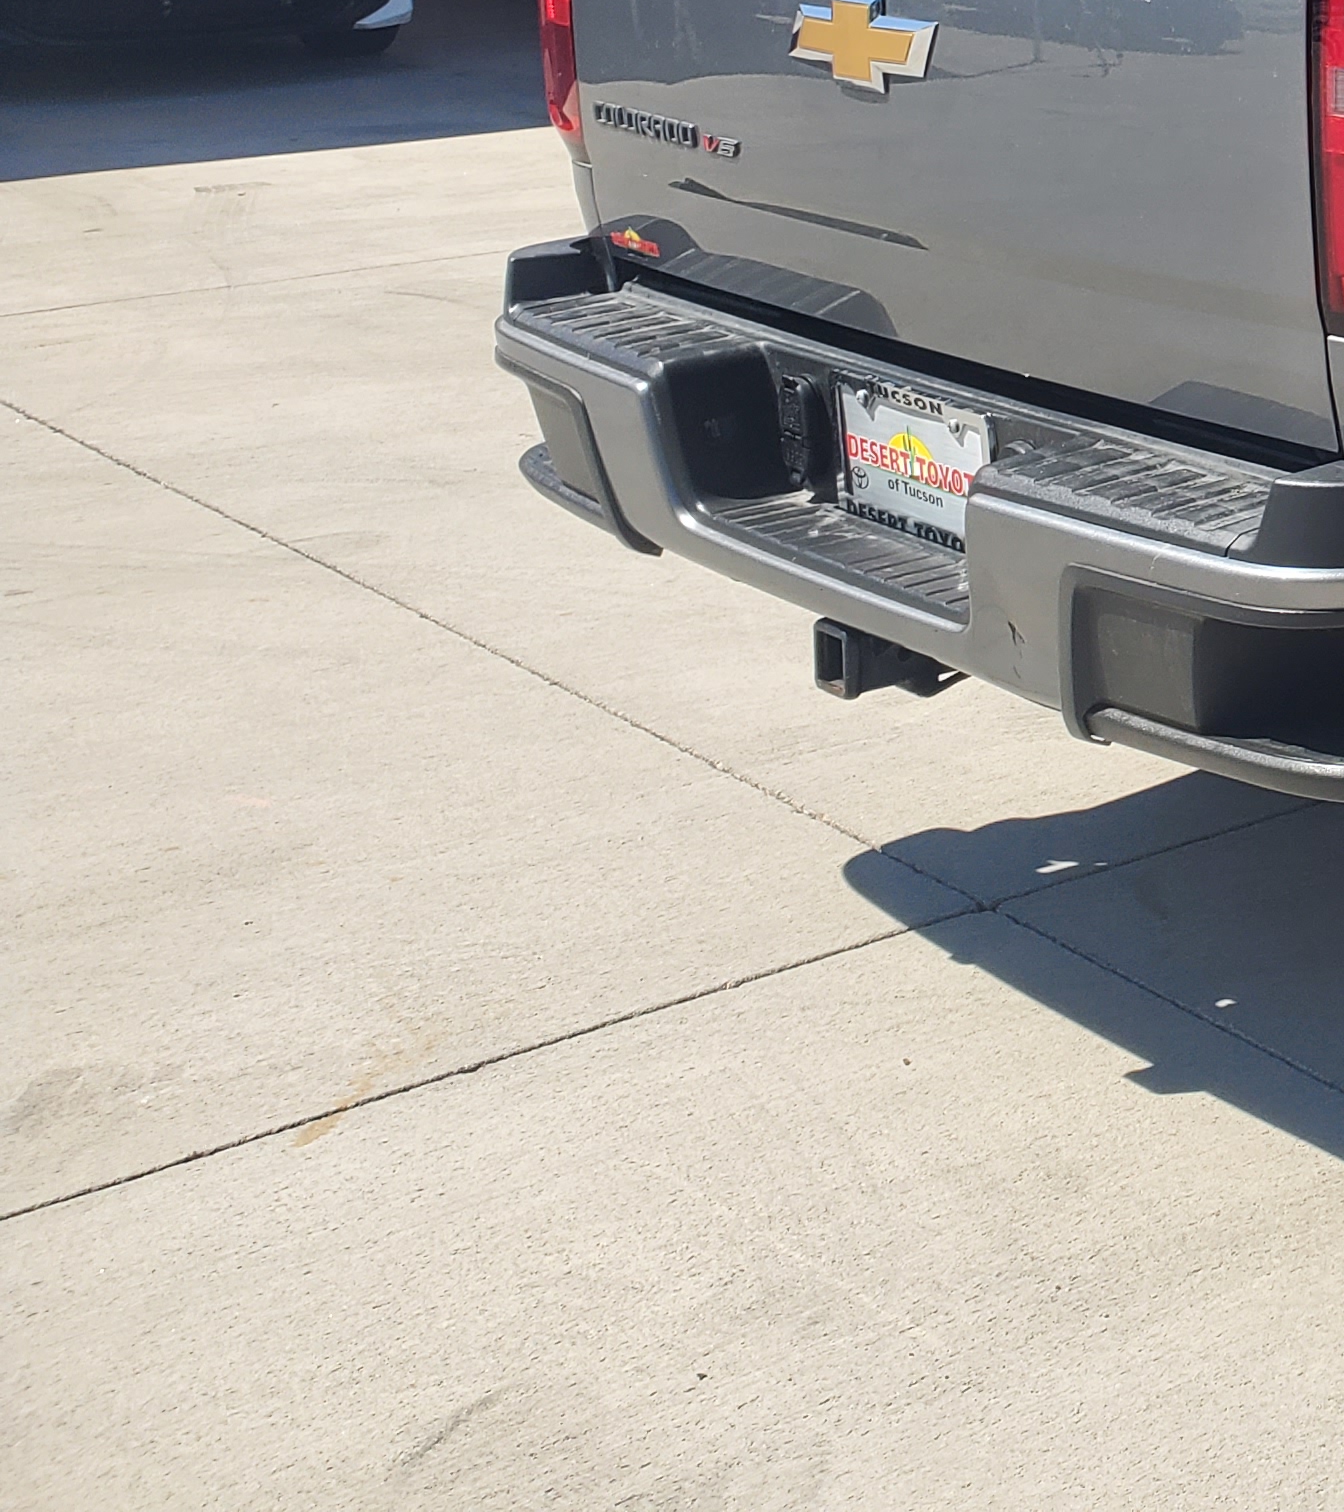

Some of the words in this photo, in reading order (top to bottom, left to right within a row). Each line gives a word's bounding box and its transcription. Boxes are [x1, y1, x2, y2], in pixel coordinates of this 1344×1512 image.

[593, 100, 698, 148] COLORADO
[703, 134, 741, 157] V6
[867, 381, 943, 415] TUCSON
[847, 433, 910, 476] DESERT
[915, 456, 975, 495] TOYOT
[887, 477, 899, 491] of
[902, 480, 943, 507] Tucson
[915, 522, 966, 554] TOYO
